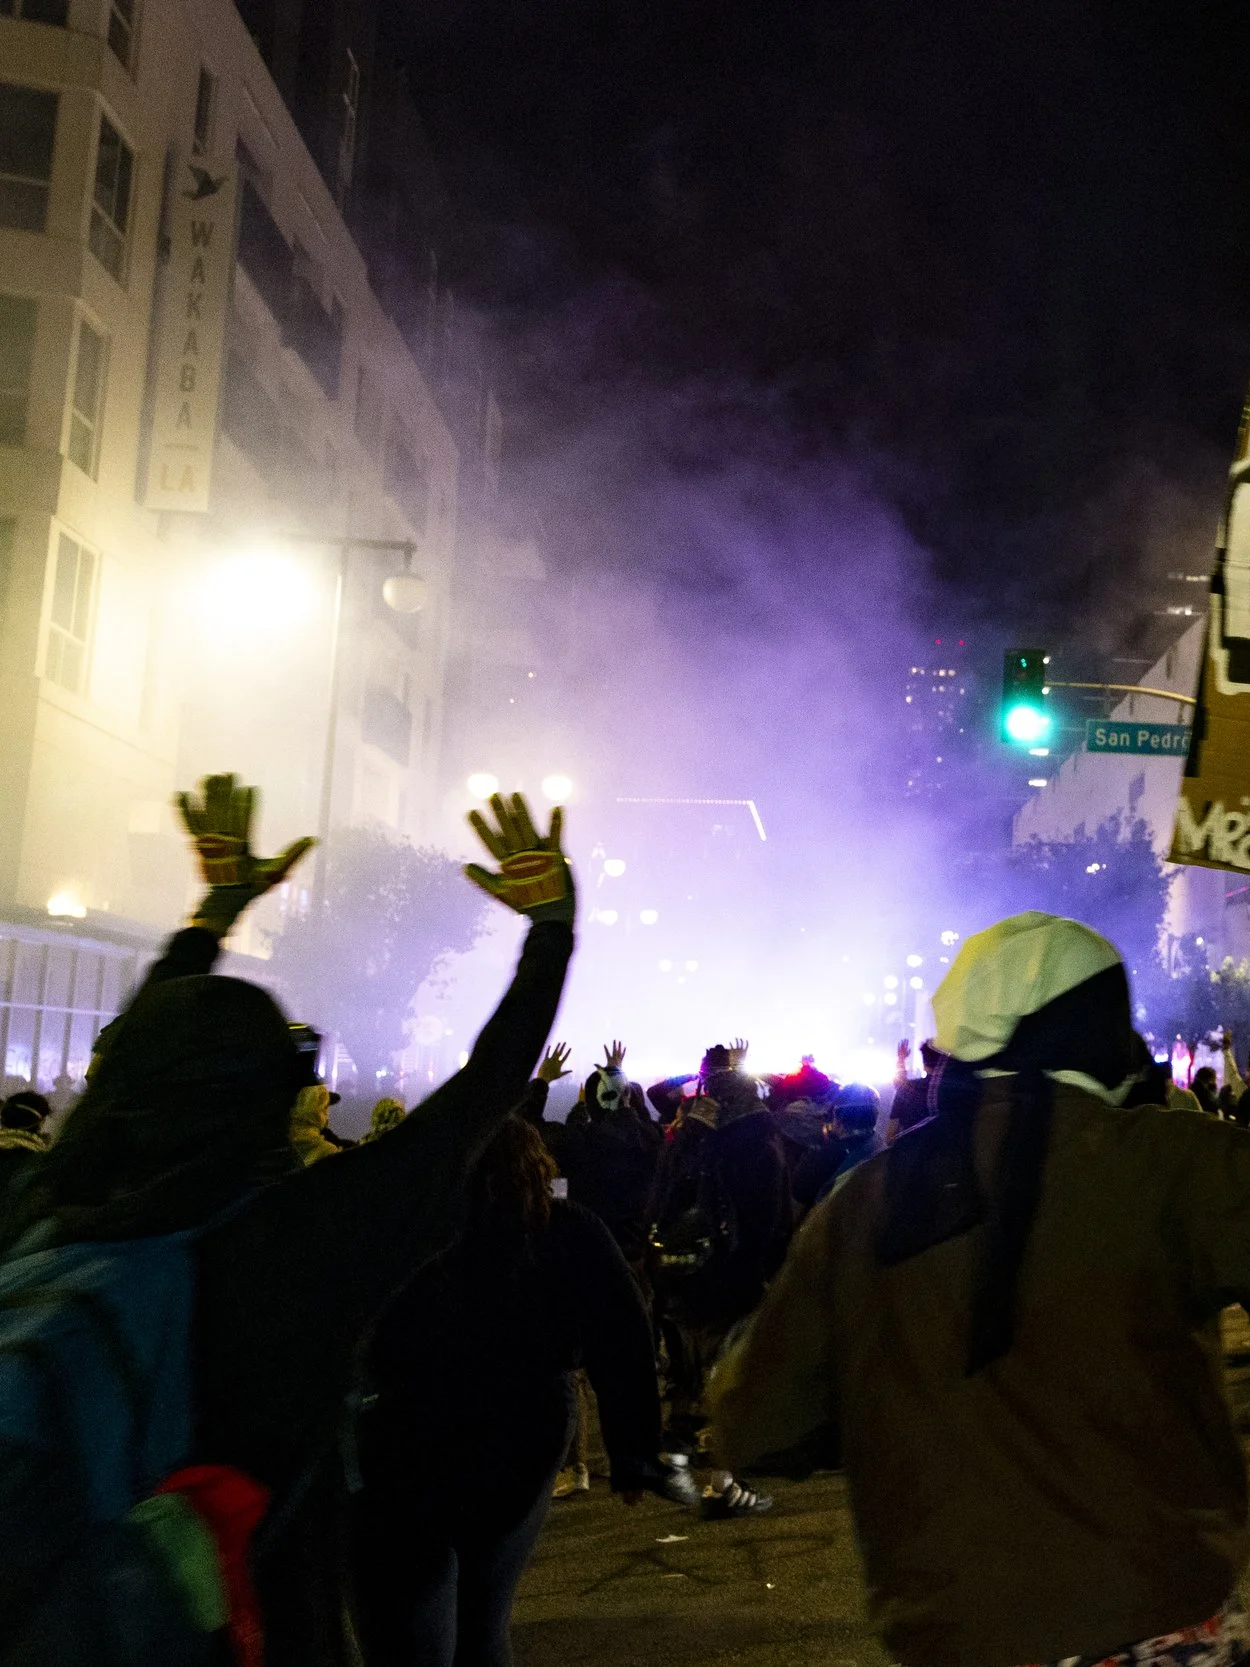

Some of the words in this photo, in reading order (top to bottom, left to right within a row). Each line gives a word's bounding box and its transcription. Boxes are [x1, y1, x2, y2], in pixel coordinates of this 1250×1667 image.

[177, 221, 215, 430] WAKABA
[160, 464, 197, 493] LA
[1095, 729, 1130, 747] San
